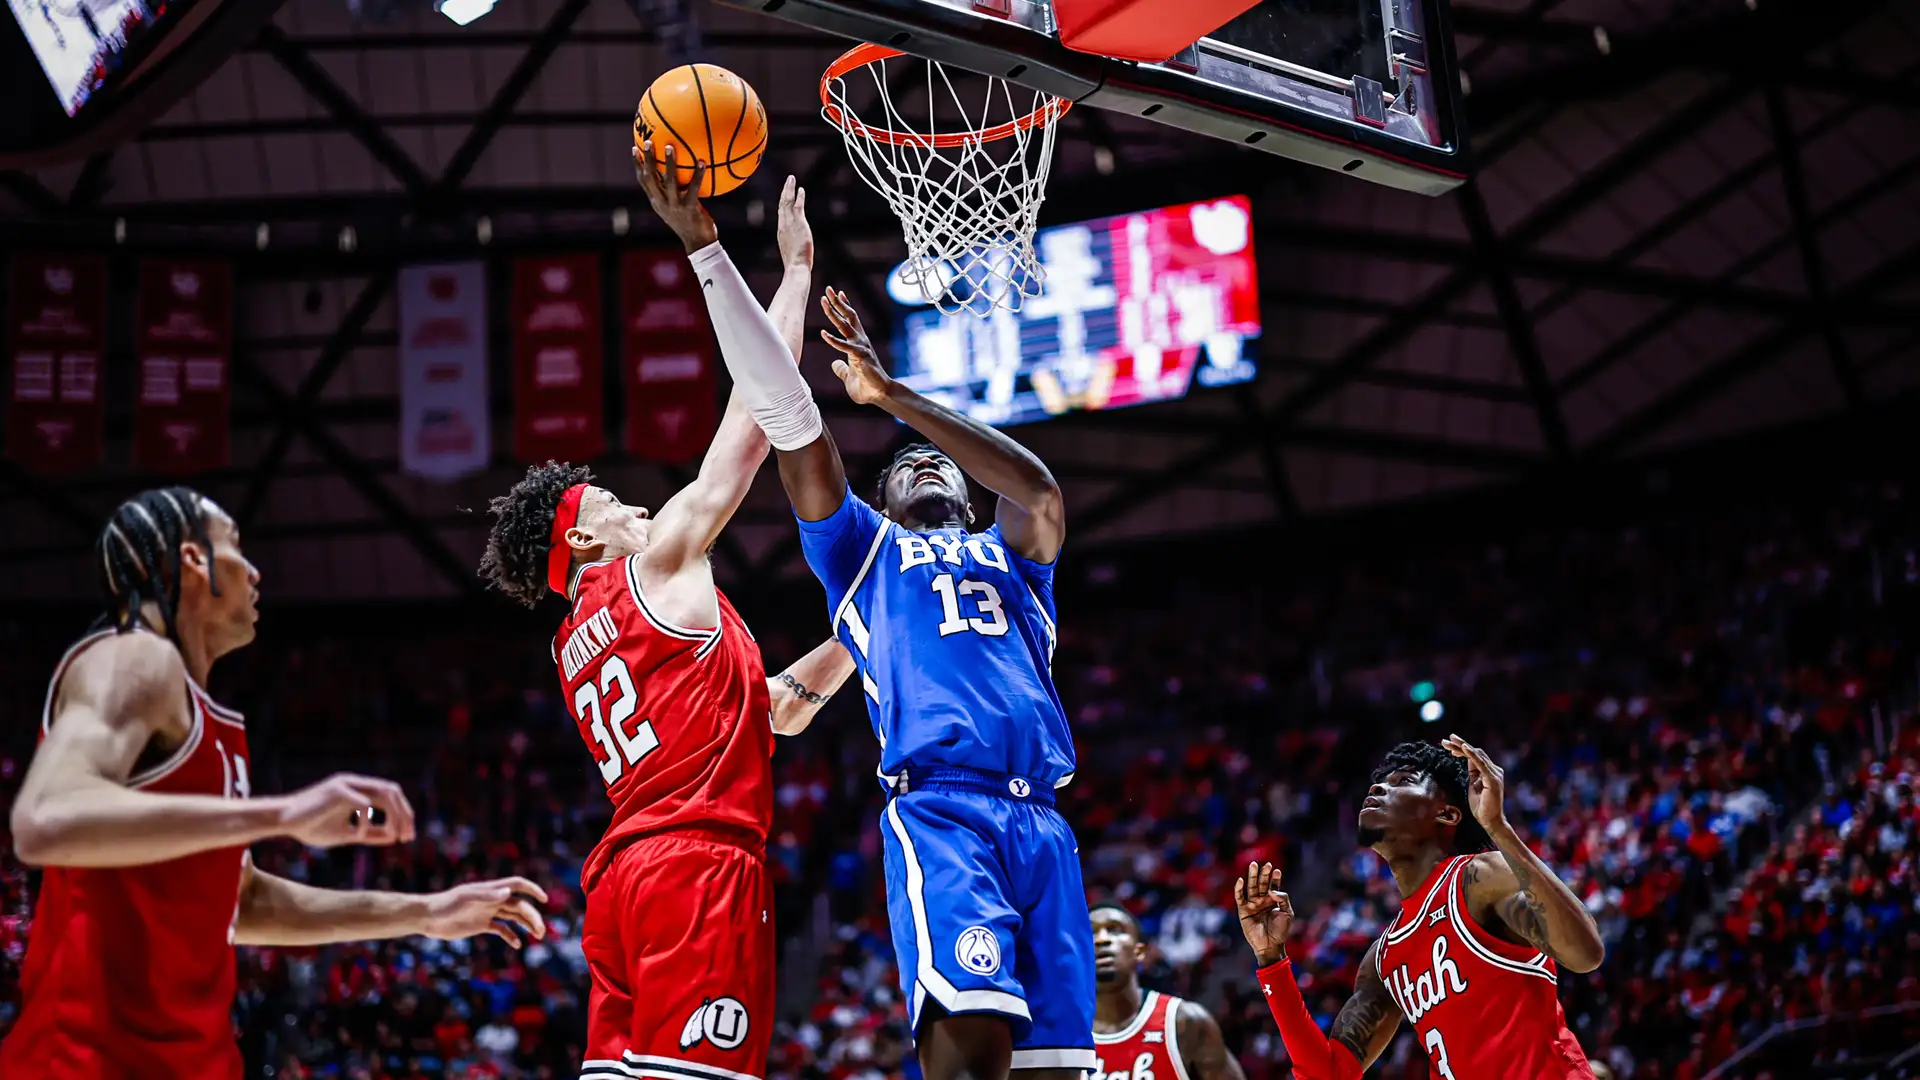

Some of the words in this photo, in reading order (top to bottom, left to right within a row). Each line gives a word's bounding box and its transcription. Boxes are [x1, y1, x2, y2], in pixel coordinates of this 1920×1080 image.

[896, 535, 1010, 574] BYU
[931, 573, 1009, 638] 13
[561, 605, 619, 683] OKUNKWO
[574, 653, 661, 786] 32
[1013, 780, 1027, 796] Y
[1383, 934, 1469, 1025] Utah
[713, 1004, 744, 1043] U
